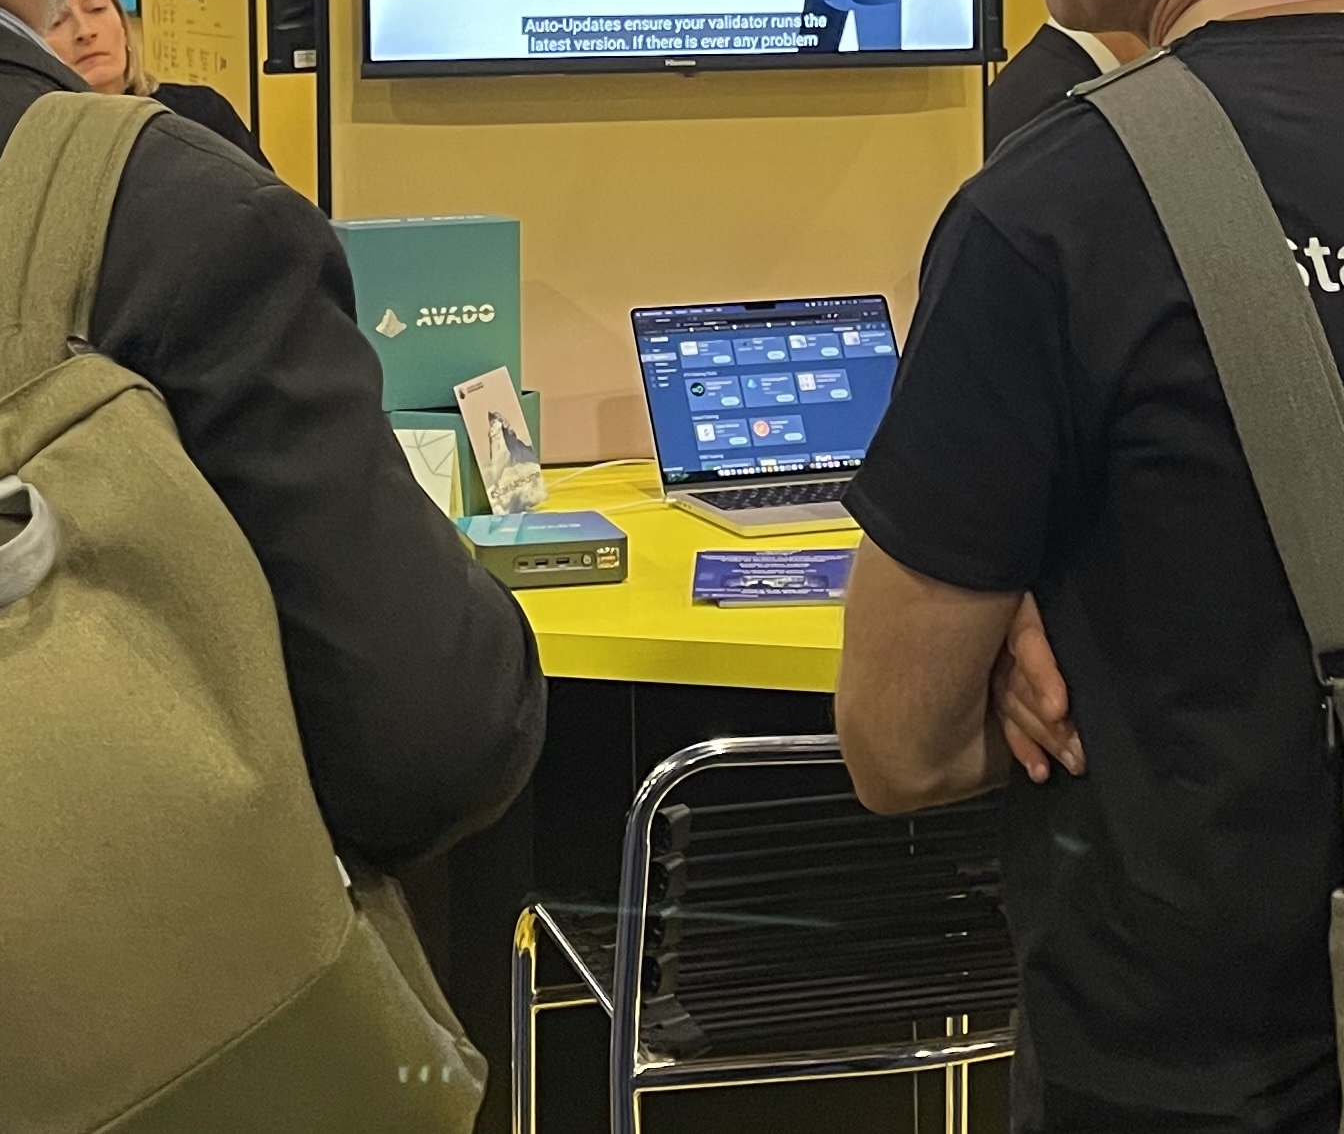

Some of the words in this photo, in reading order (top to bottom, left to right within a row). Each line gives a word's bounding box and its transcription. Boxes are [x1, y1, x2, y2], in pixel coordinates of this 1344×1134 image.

[524, 17, 622, 35] Auto-Updates
[624, 18, 672, 31] ensure
[674, 18, 706, 34] your
[708, 14, 768, 30] validator
[770, 17, 802, 29] runs
[804, 13, 827, 28] the
[530, 36, 571, 52] latest
[573, 36, 630, 52] version.
[632, 34, 644, 49] If
[645, 34, 682, 50] there
[684, 34, 698, 49] is
[700, 36, 731, 49] ever
[733, 35, 757, 52] any
[760, 32, 819, 51] problem
[415, 303, 496, 327] AVADO
